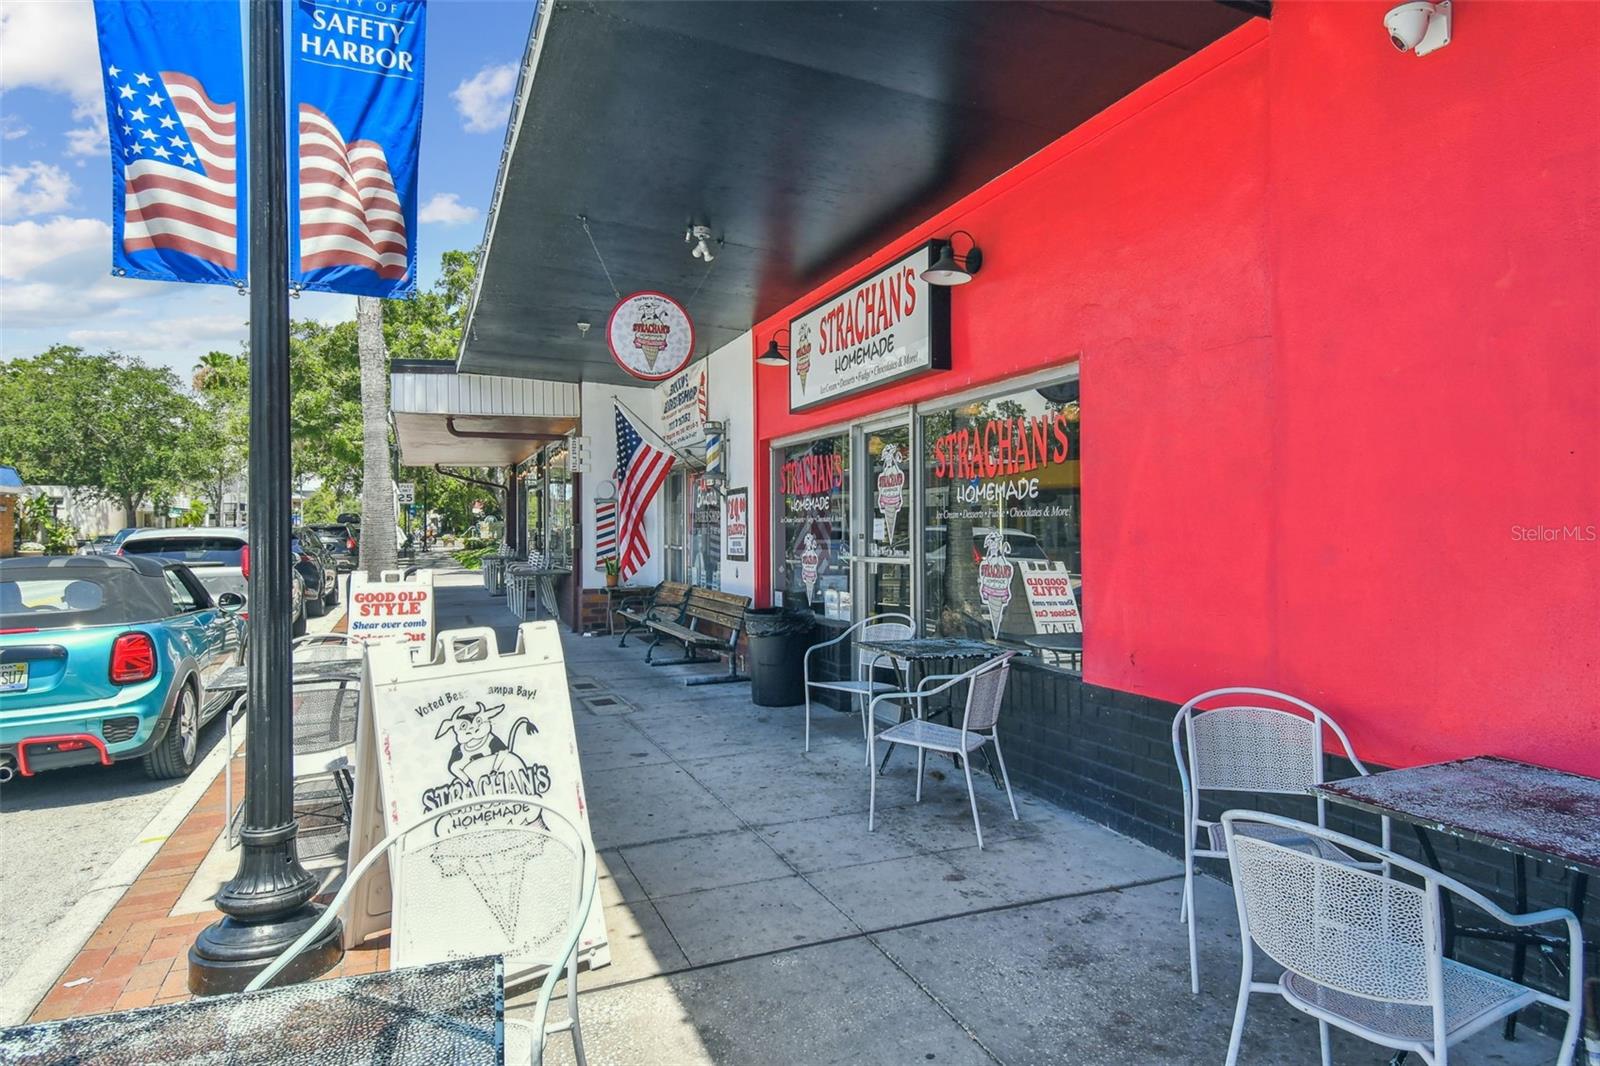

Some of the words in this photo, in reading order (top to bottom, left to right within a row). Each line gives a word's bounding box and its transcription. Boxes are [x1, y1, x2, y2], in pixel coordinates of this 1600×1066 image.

[376, 2, 398, 13] OF
[312, 9, 405, 45] SAFETY
[301, 32, 413, 73] HARBOR
[818, 265, 917, 356] STRACHAN'S
[834, 333, 895, 375] HOMEMADE
[934, 410, 1069, 480] STRACHAN'S
[780, 453, 843, 495] STRACHAN'S
[398, 494, 413, 502] 25
[790, 496, 830, 512] HOMEMADE
[957, 477, 1040, 504] HOMEMADE
[962, 509, 983, 519] Desserts
[1009, 507, 1042, 518] Chocolates
[1043, 506, 1050, 517] &
[1050, 505, 1072, 517] More!
[354, 592, 396, 604] GOOD
[398, 591, 427, 602] OLD
[360, 602, 421, 617] STYLE
[352, 621, 379, 630] Shear
[403, 619, 427, 628] comb
[414, 696, 445, 718] Voted
[488, 685, 514, 697] ampa
[516, 685, 537, 700] Bay!
[421, 763, 551, 815] STRACHAN'S
[452, 803, 531, 830] HOMEMADE
